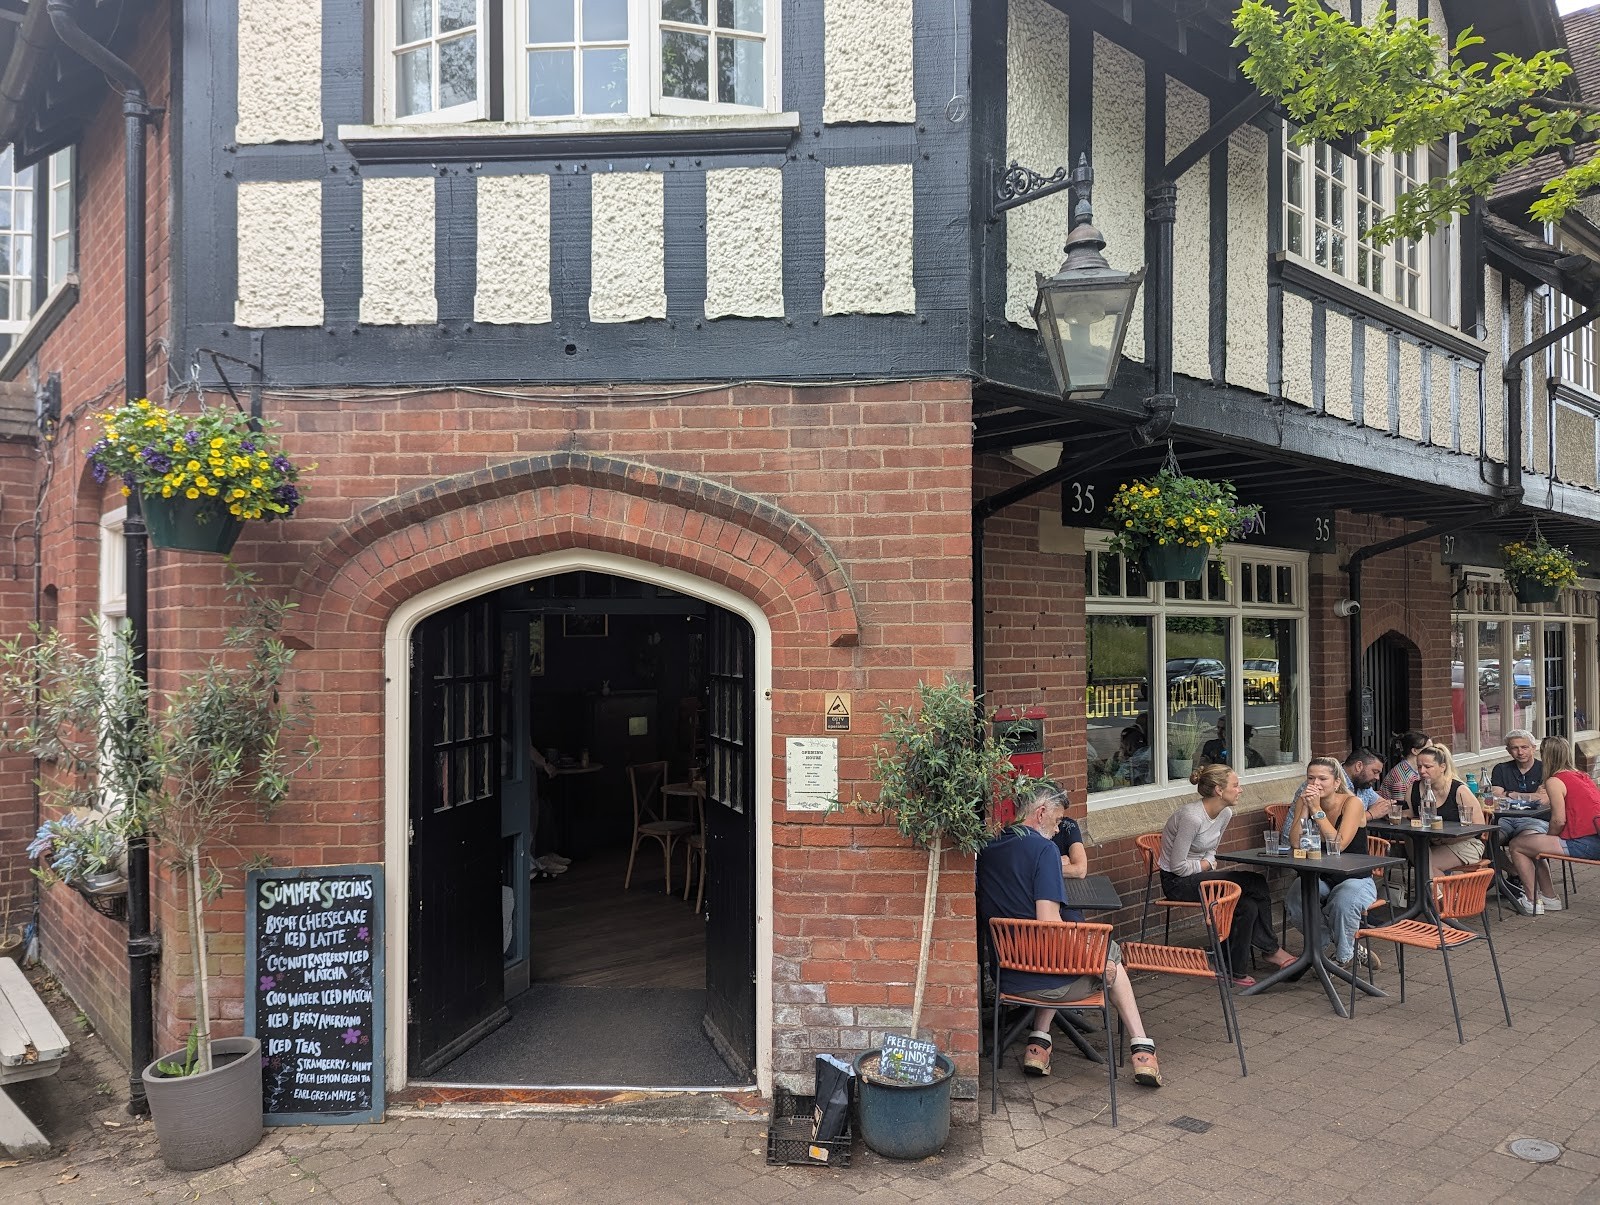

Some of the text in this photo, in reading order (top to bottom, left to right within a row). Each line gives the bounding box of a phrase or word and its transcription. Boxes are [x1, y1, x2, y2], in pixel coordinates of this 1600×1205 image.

[1071, 482, 1095, 514] 35
[1315, 517, 1330, 541] 35
[1444, 535, 1455, 554] 37
[1086, 683, 1139, 718] COFFEE
[1170, 675, 1222, 716] KAFENION
[259, 880, 372, 910] SUMMER SPECIALS
[265, 909, 368, 934] BISCOFF CHEESECAKE
[284, 929, 346, 949] ICED LATTE
[266, 953, 307, 972] COCONUT
[348, 950, 369, 965] ICED
[304, 966, 348, 984] MATCHA
[266, 990, 287, 1007] COCO
[288, 991, 321, 1008] WATER
[321, 989, 343, 1006] ICED
[268, 1011, 361, 1030] ICED BERRY AMERICANO
[268, 1038, 321, 1057] ICED TEAS
[886, 1036, 937, 1053] FREE COFFEE
[296, 1057, 346, 1072] STRAWBERRY
[351, 1061, 373, 1072] MINT
[295, 1072, 315, 1084] PEACH
[316, 1073, 341, 1085] LEMON
[341, 1074, 361, 1084] GREEN
[293, 1088, 310, 1100] EARL
[310, 1090, 329, 1102] GREY
[331, 1090, 357, 1102] MAPLE
